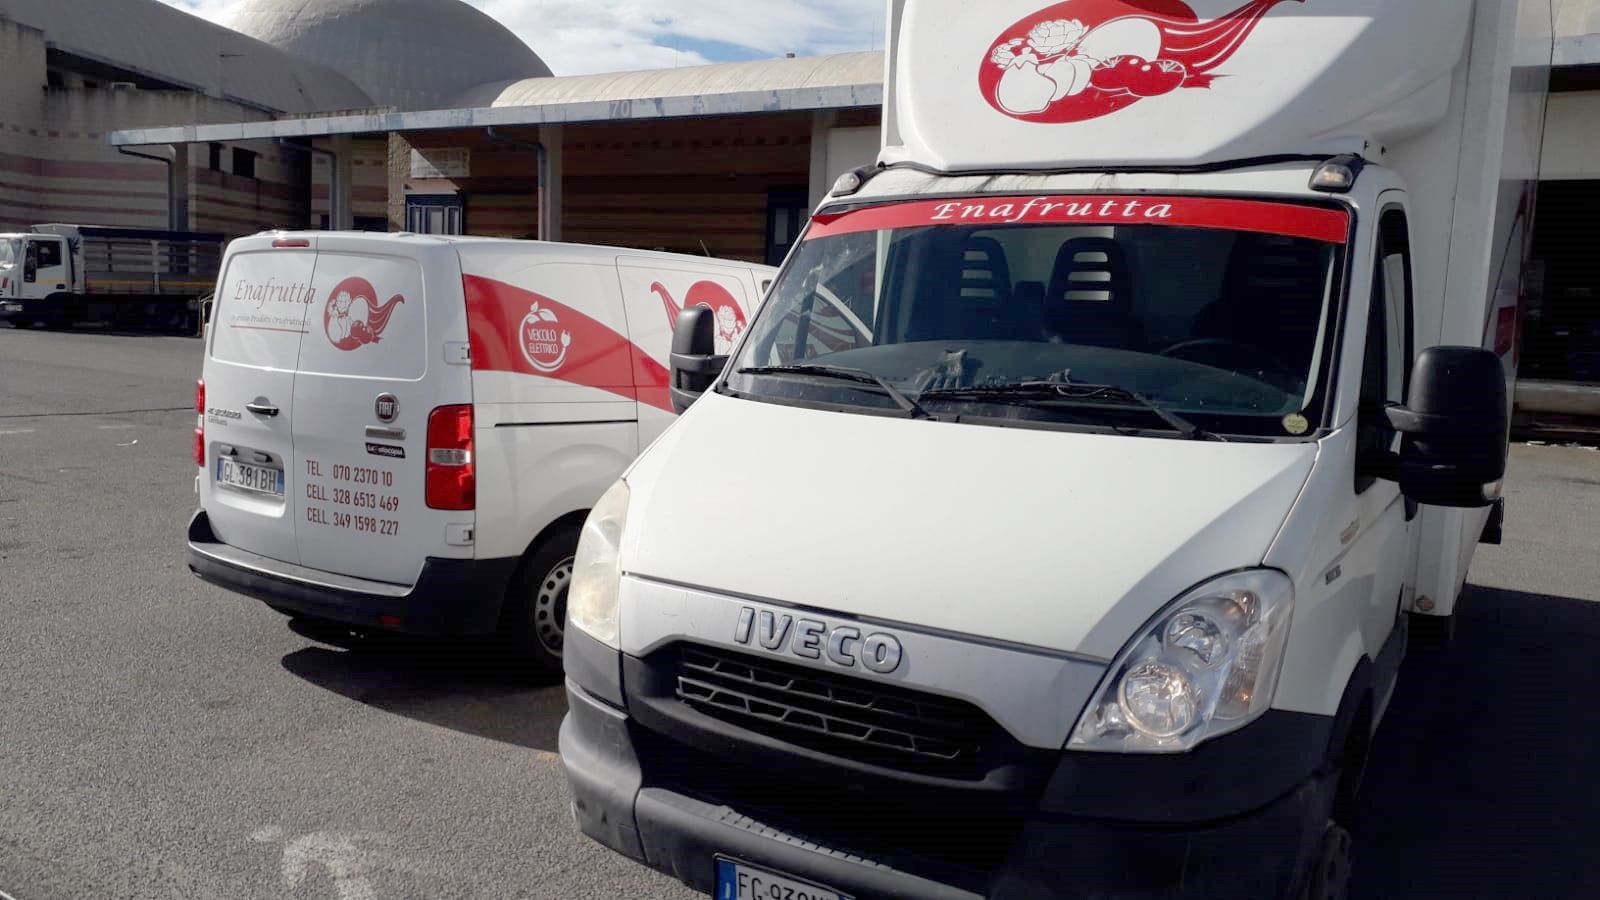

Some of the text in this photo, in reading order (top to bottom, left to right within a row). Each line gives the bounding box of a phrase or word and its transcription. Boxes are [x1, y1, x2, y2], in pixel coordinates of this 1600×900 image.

[610, 101, 630, 117] 70
[931, 197, 1172, 222] Enafrutta
[234, 277, 316, 310] Enafrutta
[527, 328, 557, 341] VEICOLO
[379, 401, 394, 416] FIAT
[333, 464, 350, 481] 070
[354, 467, 378, 485] 2370
[382, 470, 393, 487] 10
[333, 488, 350, 505] 328
[354, 491, 376, 509] 6513
[380, 495, 399, 512] 469
[333, 511, 351, 529] 349
[354, 515, 376, 533] 1598
[380, 519, 399, 536] 227
[734, 606, 903, 674] IVECO
